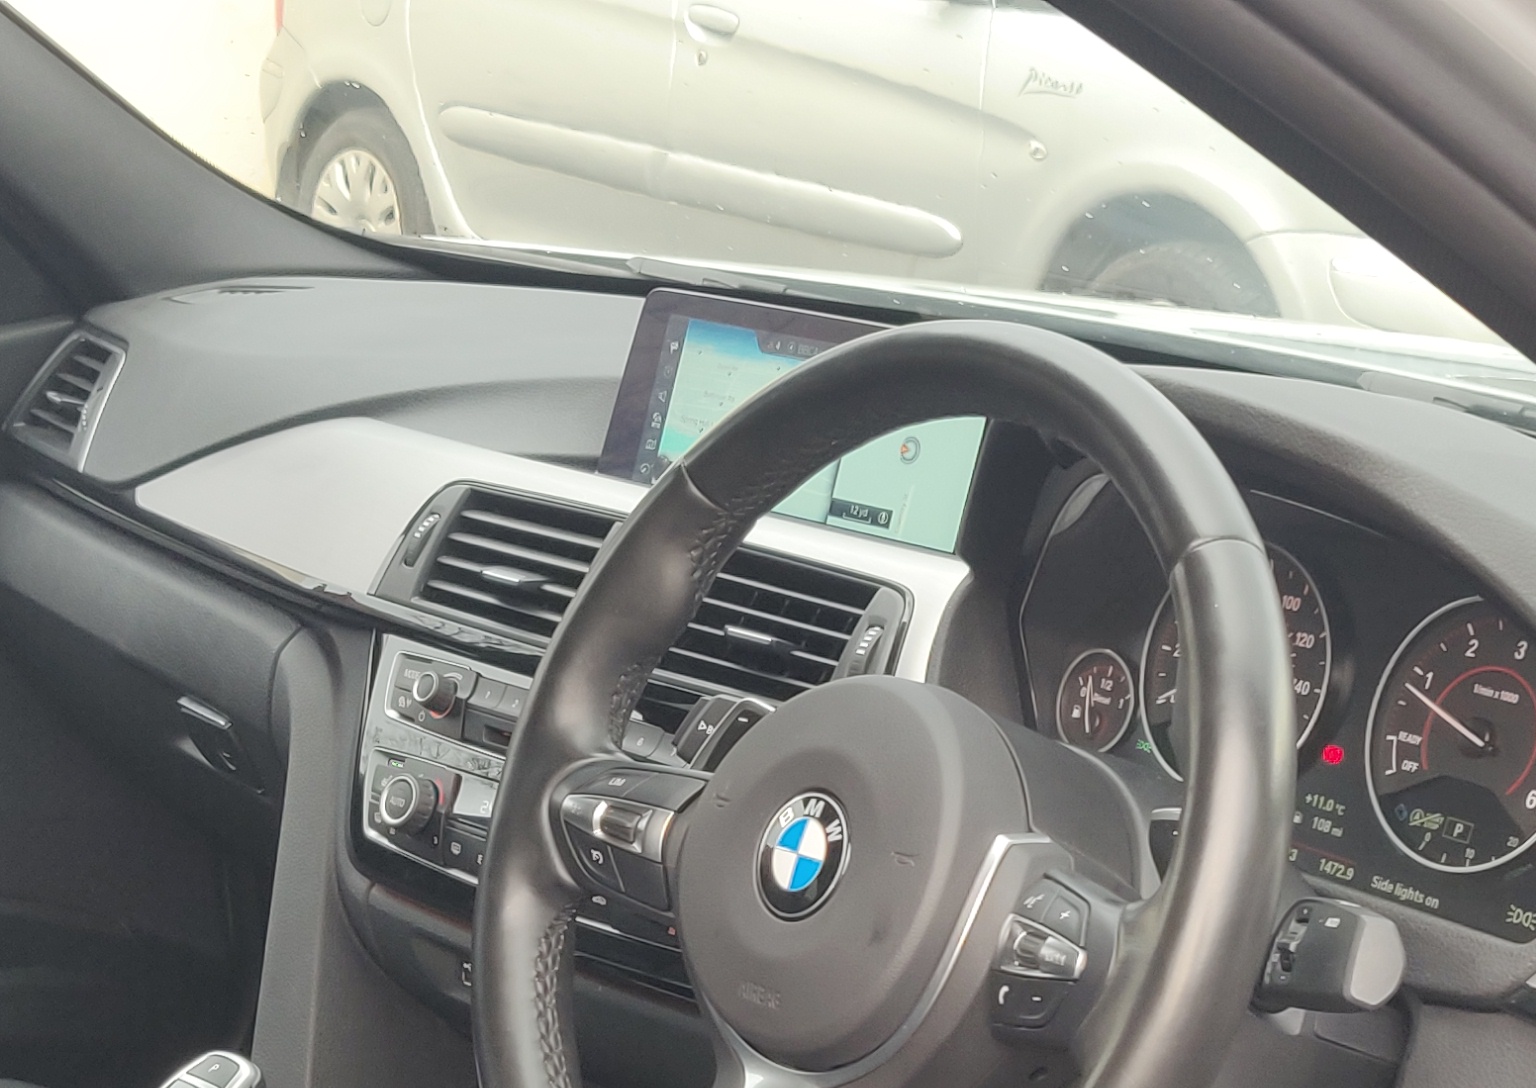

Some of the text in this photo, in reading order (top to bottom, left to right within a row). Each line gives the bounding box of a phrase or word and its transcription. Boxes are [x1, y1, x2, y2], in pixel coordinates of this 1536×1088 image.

[1295, 632, 1315, 649] 120
[1464, 639, 1479, 658] 2
[1514, 640, 1529, 660] 3
[1422, 671, 1434, 690] 1
[1397, 730, 1423, 746] READY
[1401, 759, 1420, 773] OFF
[1305, 792, 1335, 813] +11.0
[778, 798, 843, 842] BMW
[1311, 816, 1344, 838] 108 mi
[1424, 832, 1432, 843] 0
[1452, 822, 1465, 837] P
[1506, 836, 1520, 848] 20
[1465, 847, 1476, 859] 10
[1319, 857, 1356, 881] 1472.9
[1370, 875, 1440, 909] Side lights on
[208, 1063, 220, 1073] P
